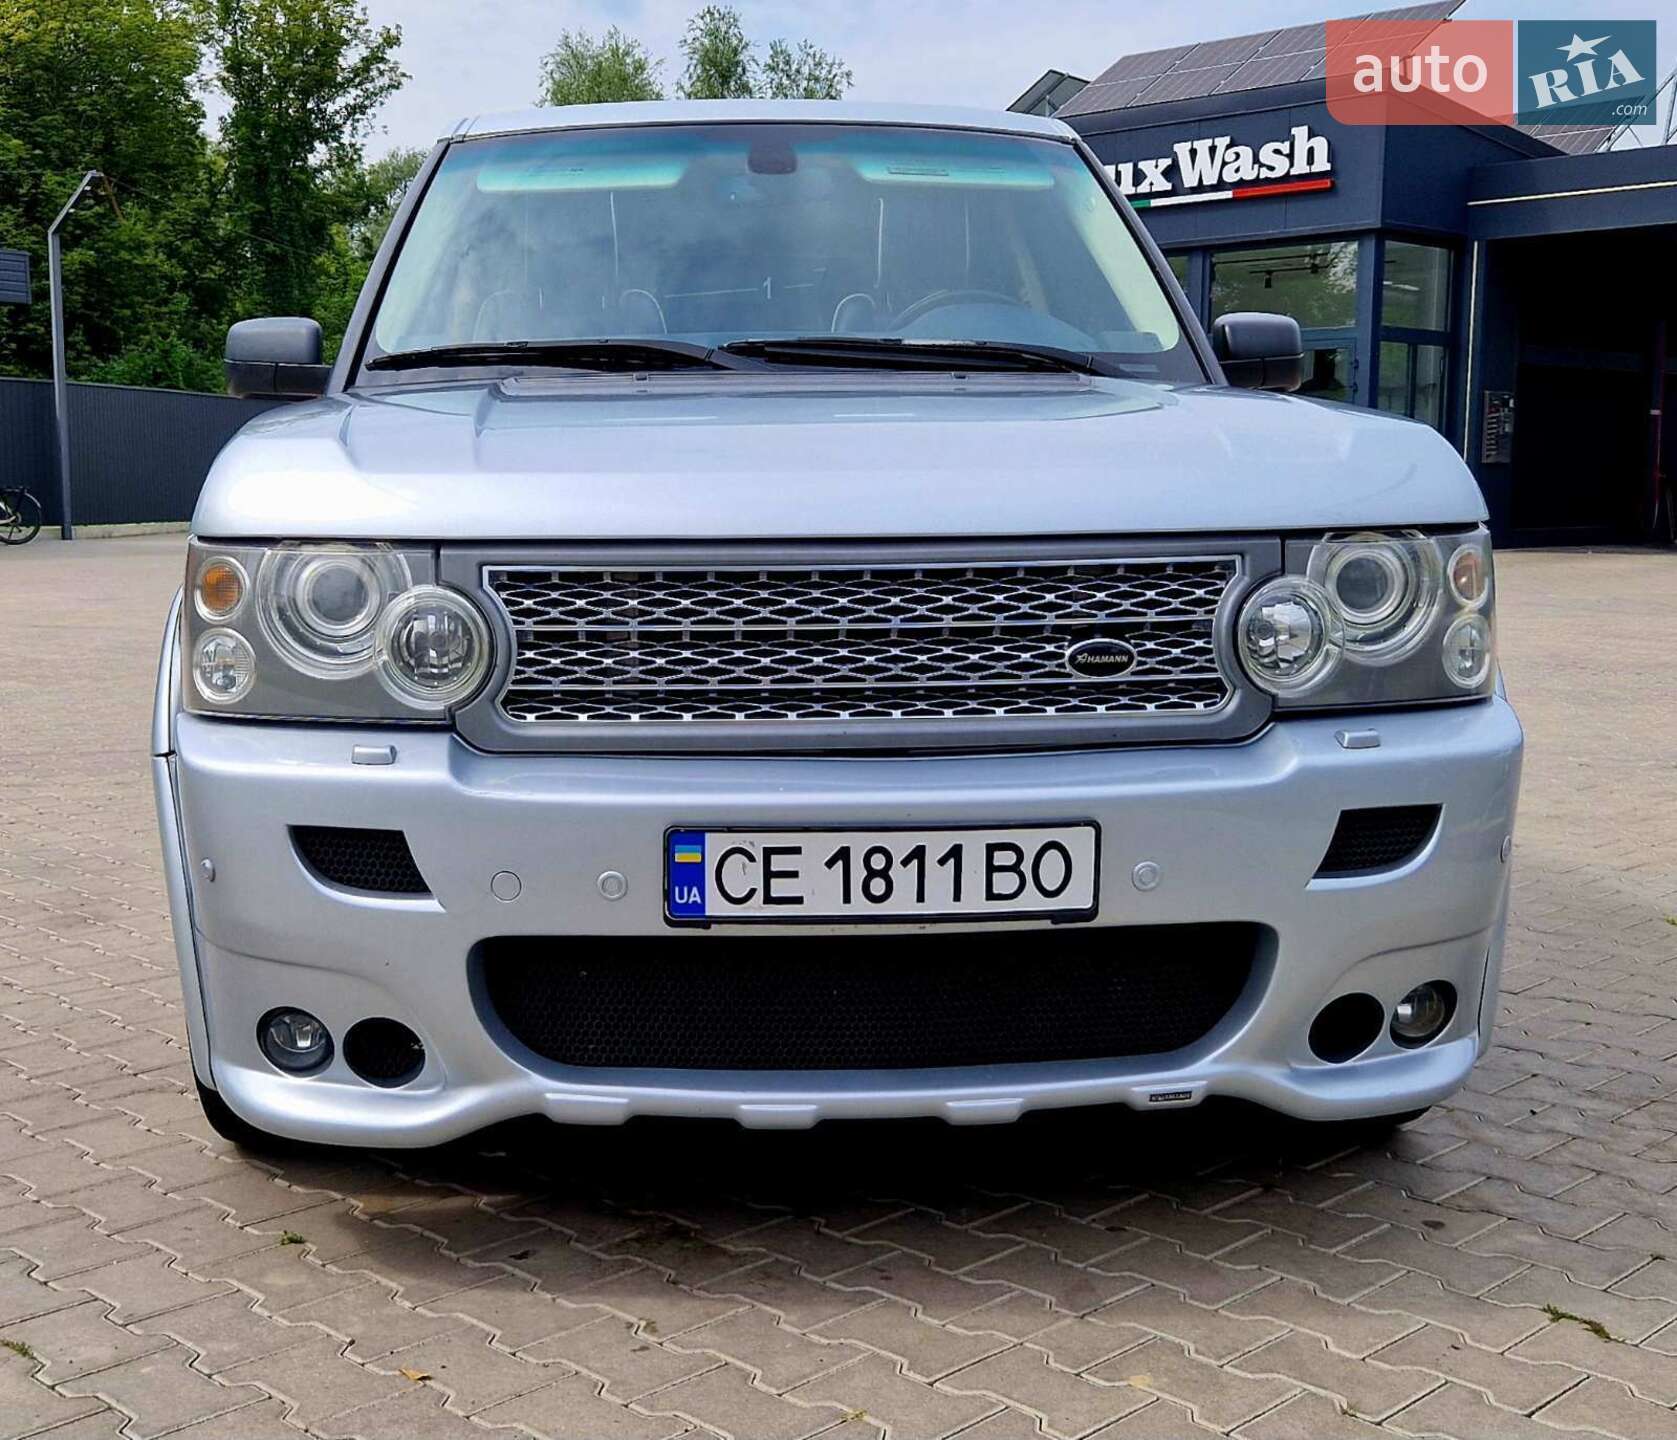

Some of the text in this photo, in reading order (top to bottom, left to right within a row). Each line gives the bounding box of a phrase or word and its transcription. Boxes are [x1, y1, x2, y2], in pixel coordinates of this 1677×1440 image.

[714, 840, 1073, 906] CE 1811 BO
[674, 886, 702, 905] UA
